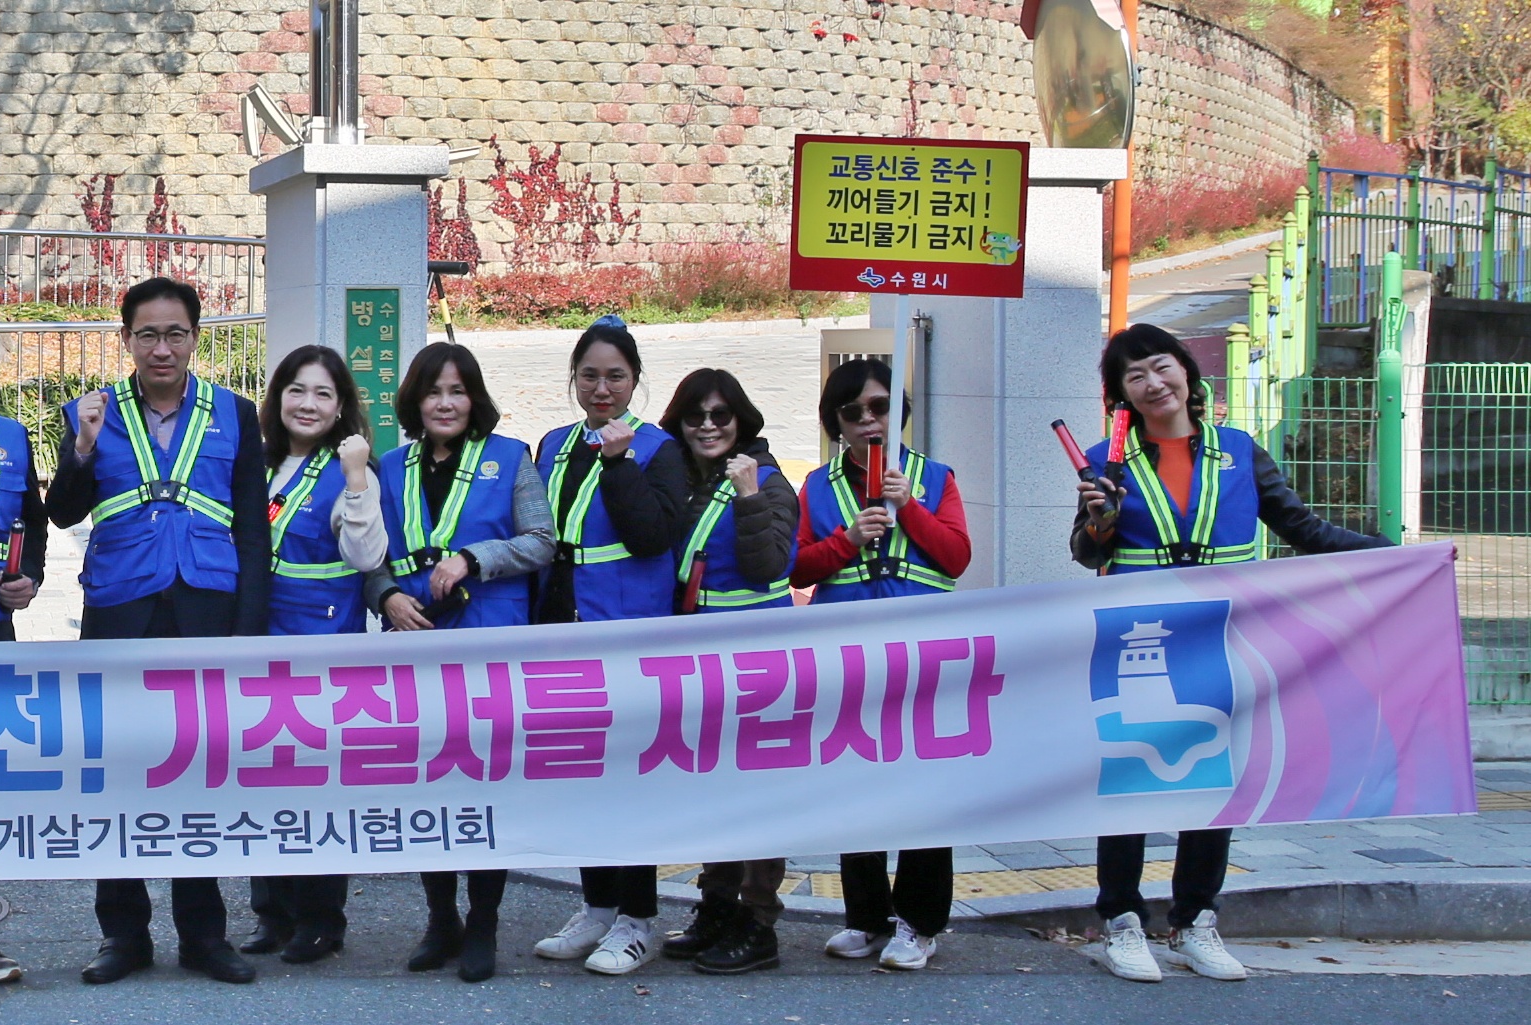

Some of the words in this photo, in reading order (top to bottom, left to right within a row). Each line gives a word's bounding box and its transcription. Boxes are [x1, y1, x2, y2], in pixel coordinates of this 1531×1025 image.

[828, 154, 921, 182] 교통신호
[826, 187, 919, 216] 끼어들기
[825, 221, 918, 249] 꼬리물기
[378, 302, 395, 427] 수일초등학교
[142, 659, 614, 790] 기초질서를
[638, 634, 1006, 776] 지킵시다
